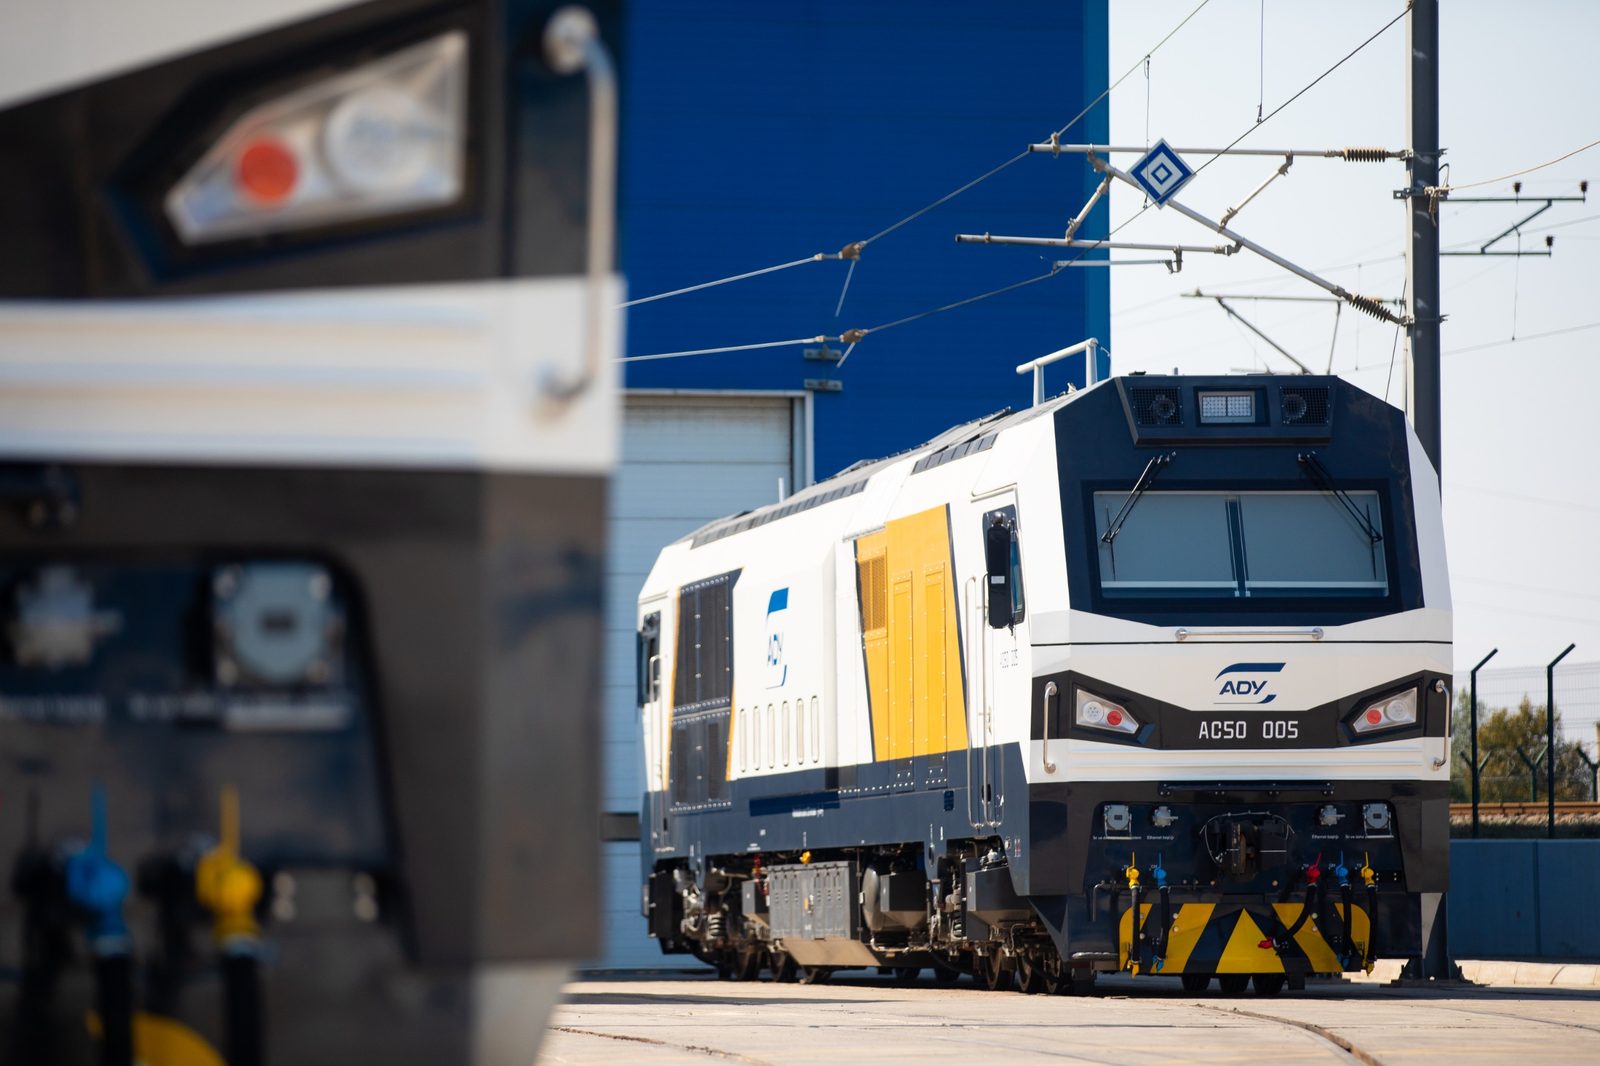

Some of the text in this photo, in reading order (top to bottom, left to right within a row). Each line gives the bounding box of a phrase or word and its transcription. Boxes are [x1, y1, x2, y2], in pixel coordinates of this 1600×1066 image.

[1219, 680, 1268, 695] ADY
[1198, 721, 1298, 739] AC50 005
